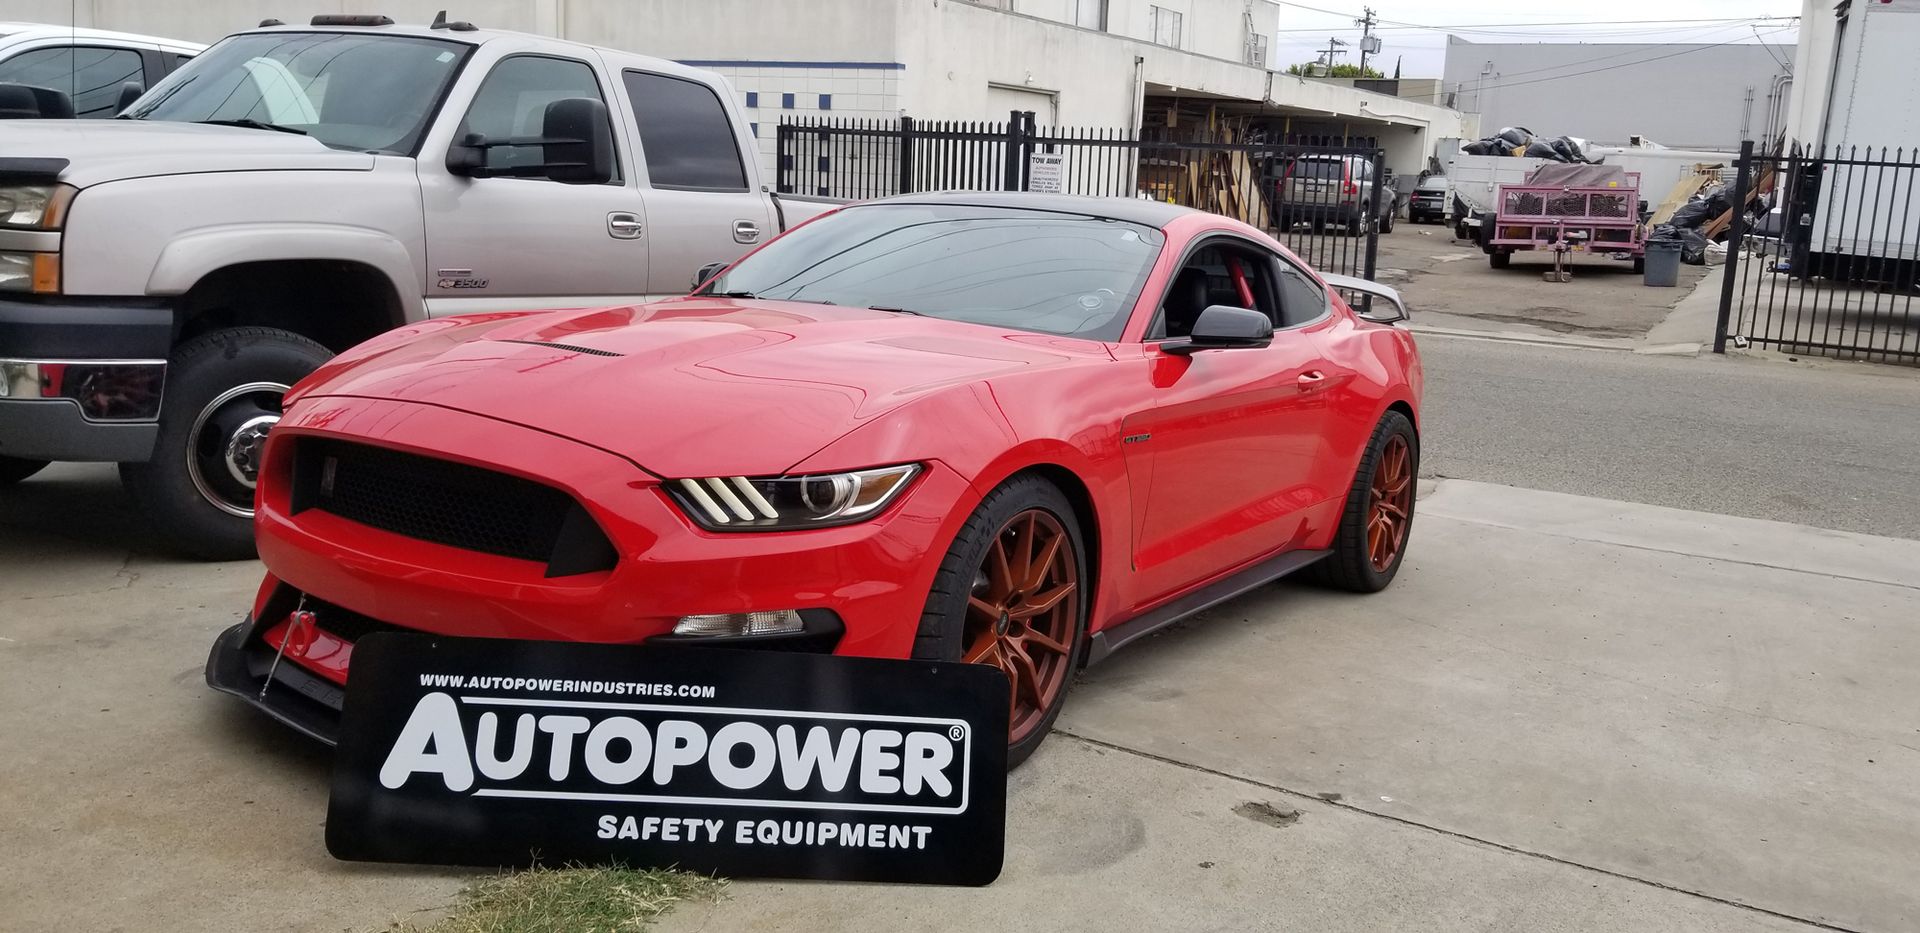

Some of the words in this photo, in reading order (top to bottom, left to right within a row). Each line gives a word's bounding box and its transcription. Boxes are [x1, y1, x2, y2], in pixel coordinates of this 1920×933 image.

[454, 278, 489, 288] 3500
[419, 674, 715, 698] WWW.AUTOPOWERINDUSTRIES.COM
[380, 692, 954, 797] AUTOPOWER
[597, 814, 724, 843] SAFETY
[736, 820, 933, 850] EQUIPMENT
